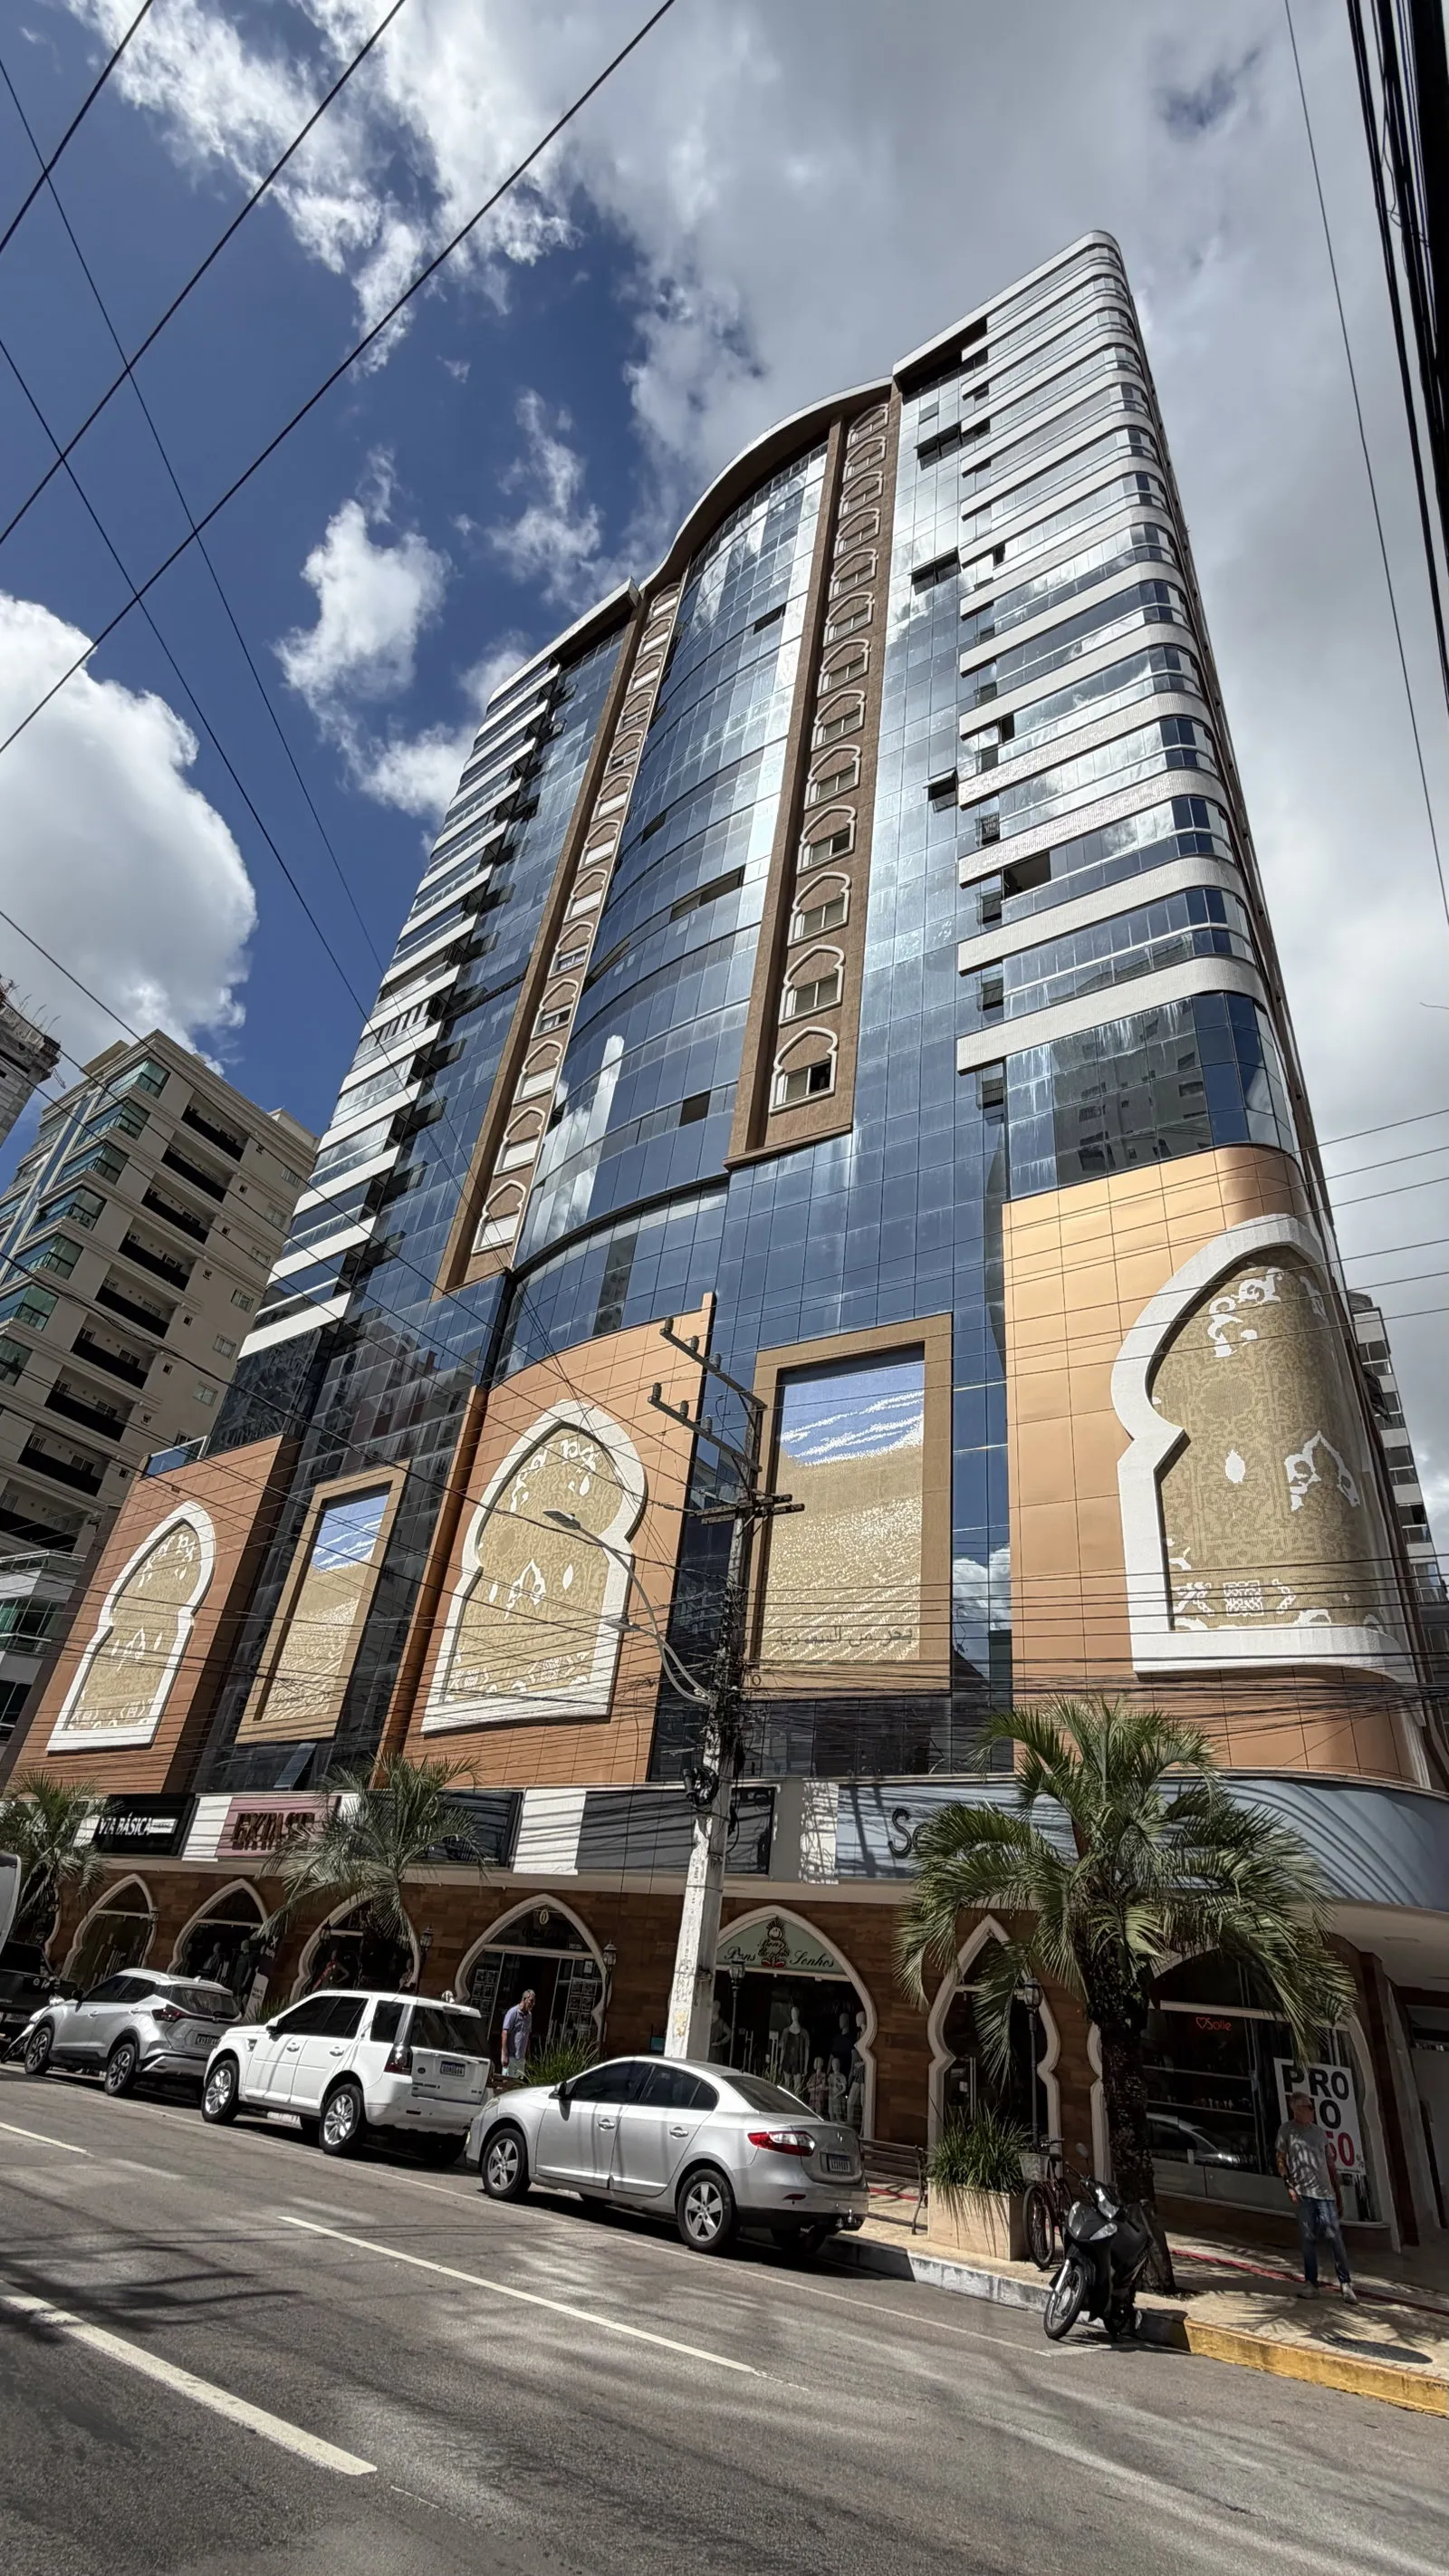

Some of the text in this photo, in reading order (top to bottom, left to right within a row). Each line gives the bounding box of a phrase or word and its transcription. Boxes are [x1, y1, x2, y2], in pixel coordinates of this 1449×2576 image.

[115, 1812, 152, 1836] BÁSICA
[724, 1946, 834, 1967] Bns Sonhos
[1281, 2064, 1349, 2100] PRO
